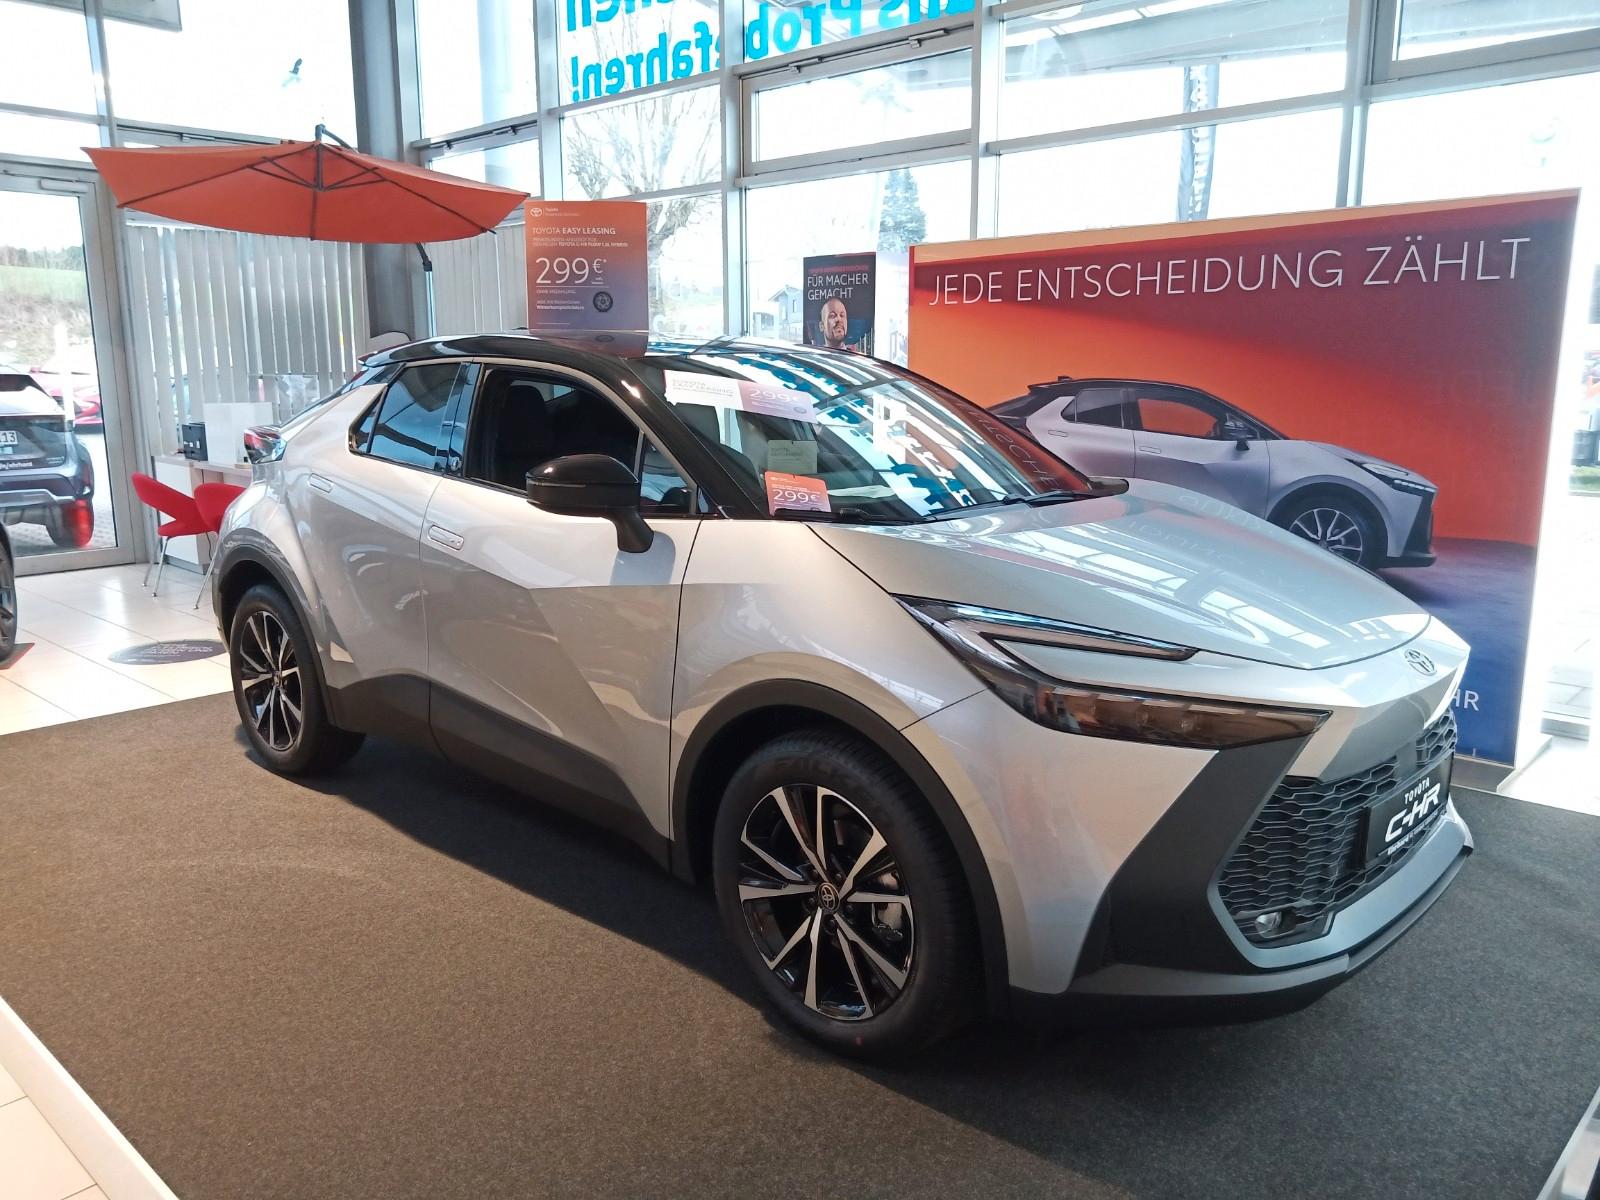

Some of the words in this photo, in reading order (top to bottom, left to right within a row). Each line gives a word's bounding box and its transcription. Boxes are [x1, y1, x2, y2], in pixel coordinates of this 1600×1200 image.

[533, 227, 561, 235] TOYOTA
[562, 227, 581, 235] EASY
[583, 227, 616, 235] LEASING
[807, 273, 824, 288] FÜR
[825, 273, 870, 287] MACHER
[928, 271, 1003, 306] JEDE
[1016, 249, 1343, 302] ENTSCHEIDUNG
[1363, 235, 1531, 286] ZÄHLT
[807, 287, 854, 301] GEMACHT
[1404, 777, 1430, 805] TOYOTA
[1384, 782, 1441, 843] C-HR
